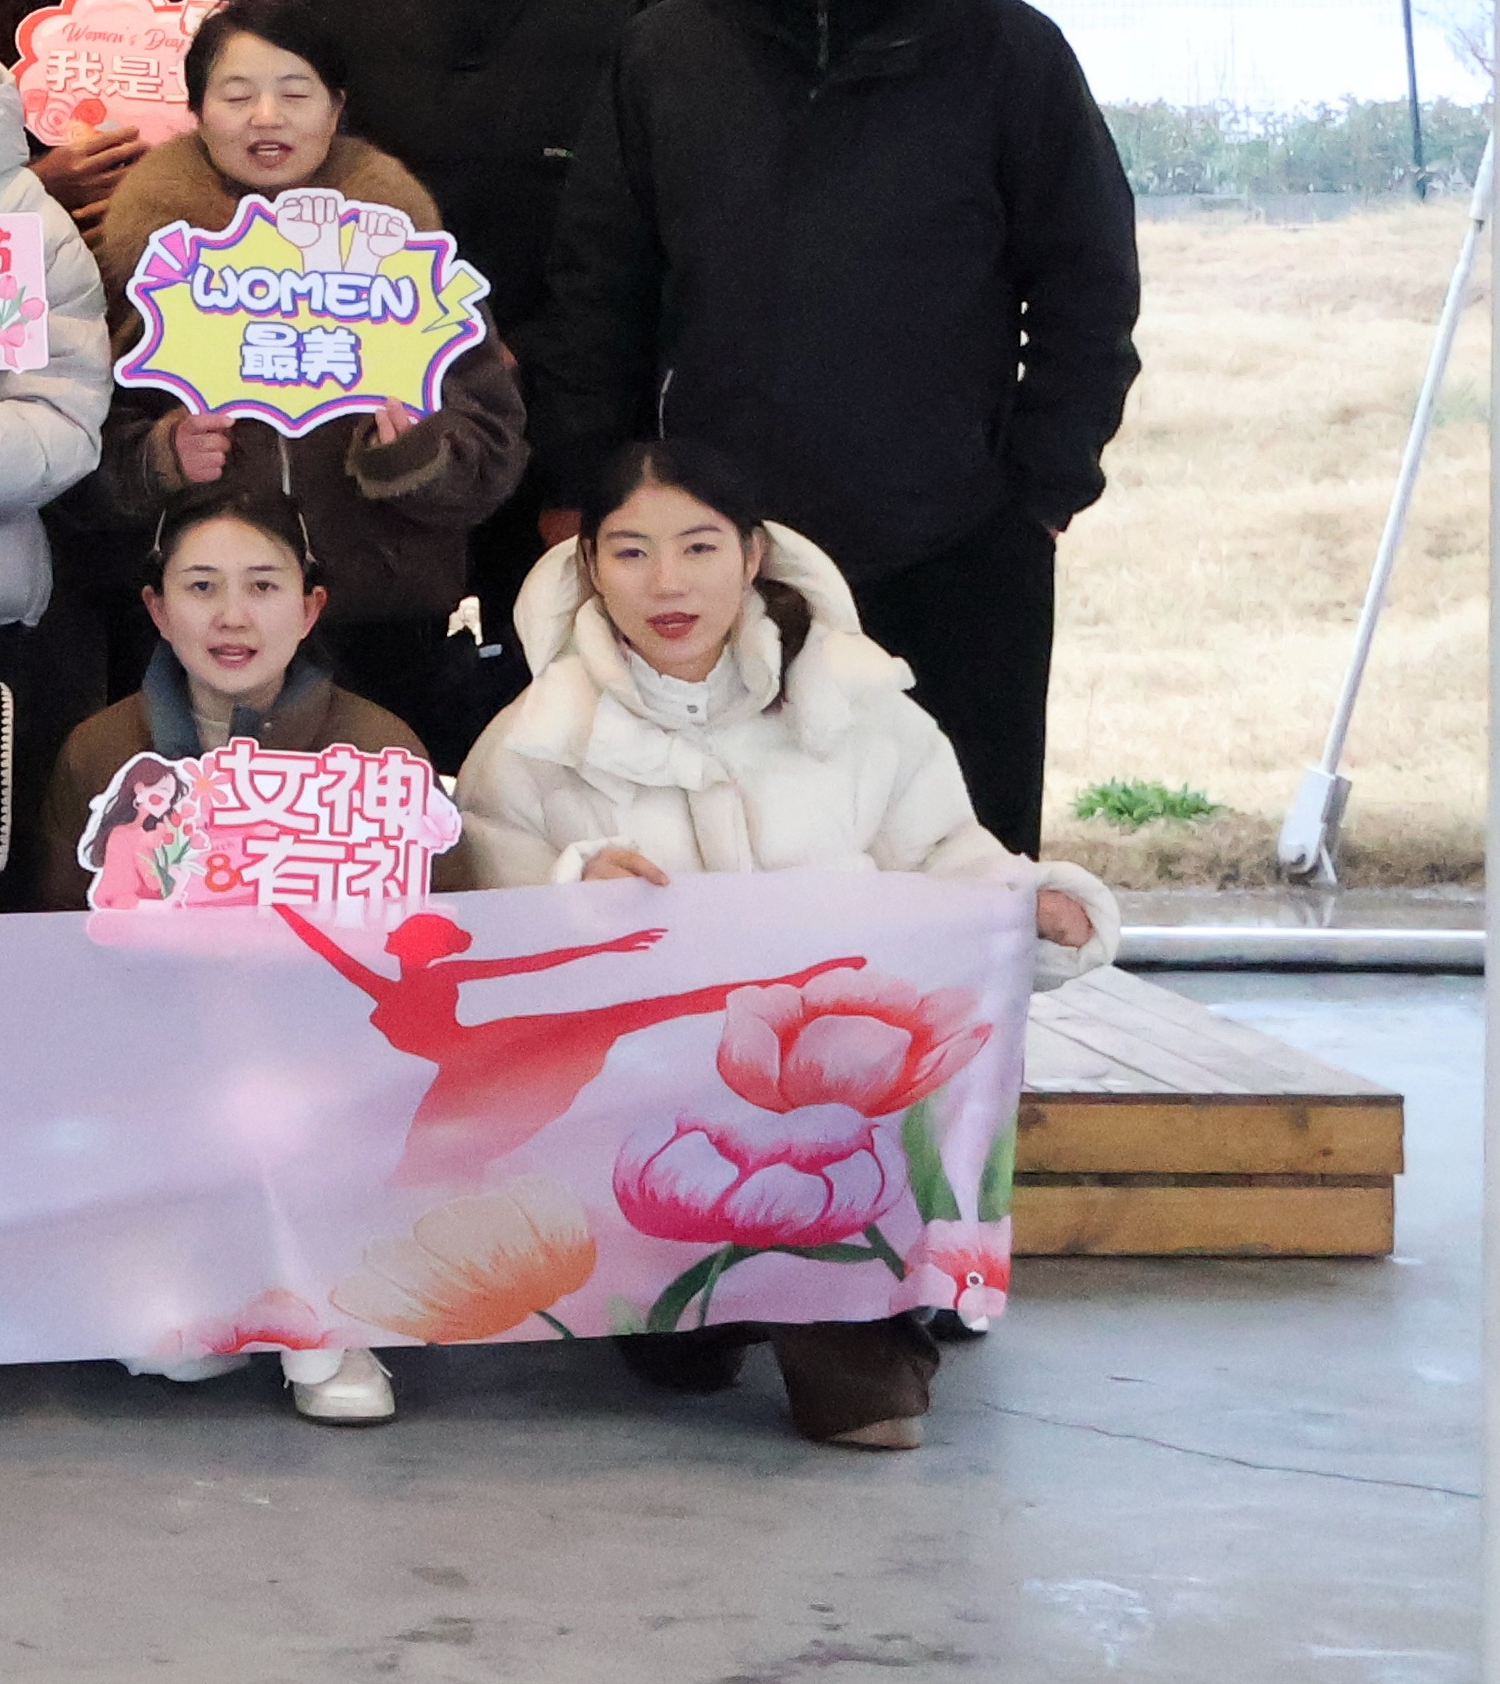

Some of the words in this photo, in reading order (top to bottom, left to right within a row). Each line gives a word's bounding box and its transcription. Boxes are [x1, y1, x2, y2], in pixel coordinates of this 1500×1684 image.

[62, 21, 137, 47] Women's
[144, 28, 187, 53] Day
[191, 264, 420, 324] WOMEN
[240, 321, 363, 392] 最美
[209, 739, 430, 840] 女神
[241, 830, 432, 905] 有礼
